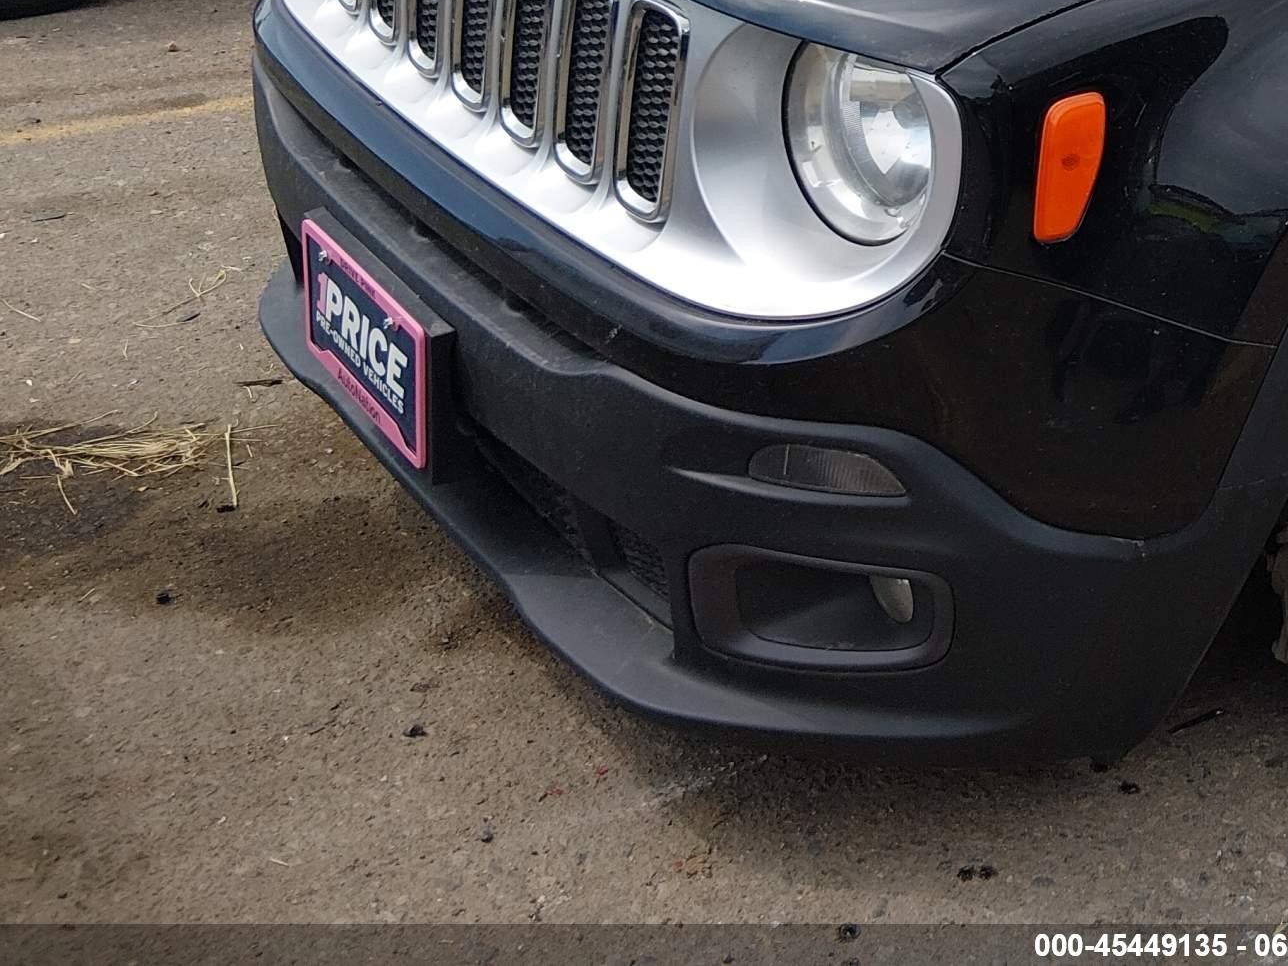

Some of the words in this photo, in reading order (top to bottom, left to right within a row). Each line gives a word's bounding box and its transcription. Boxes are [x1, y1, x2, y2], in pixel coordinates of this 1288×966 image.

[316, 310, 361, 368] PRE-OWNED
[363, 361, 405, 415] VEHICLES
[337, 368, 381, 424] AutoNation
